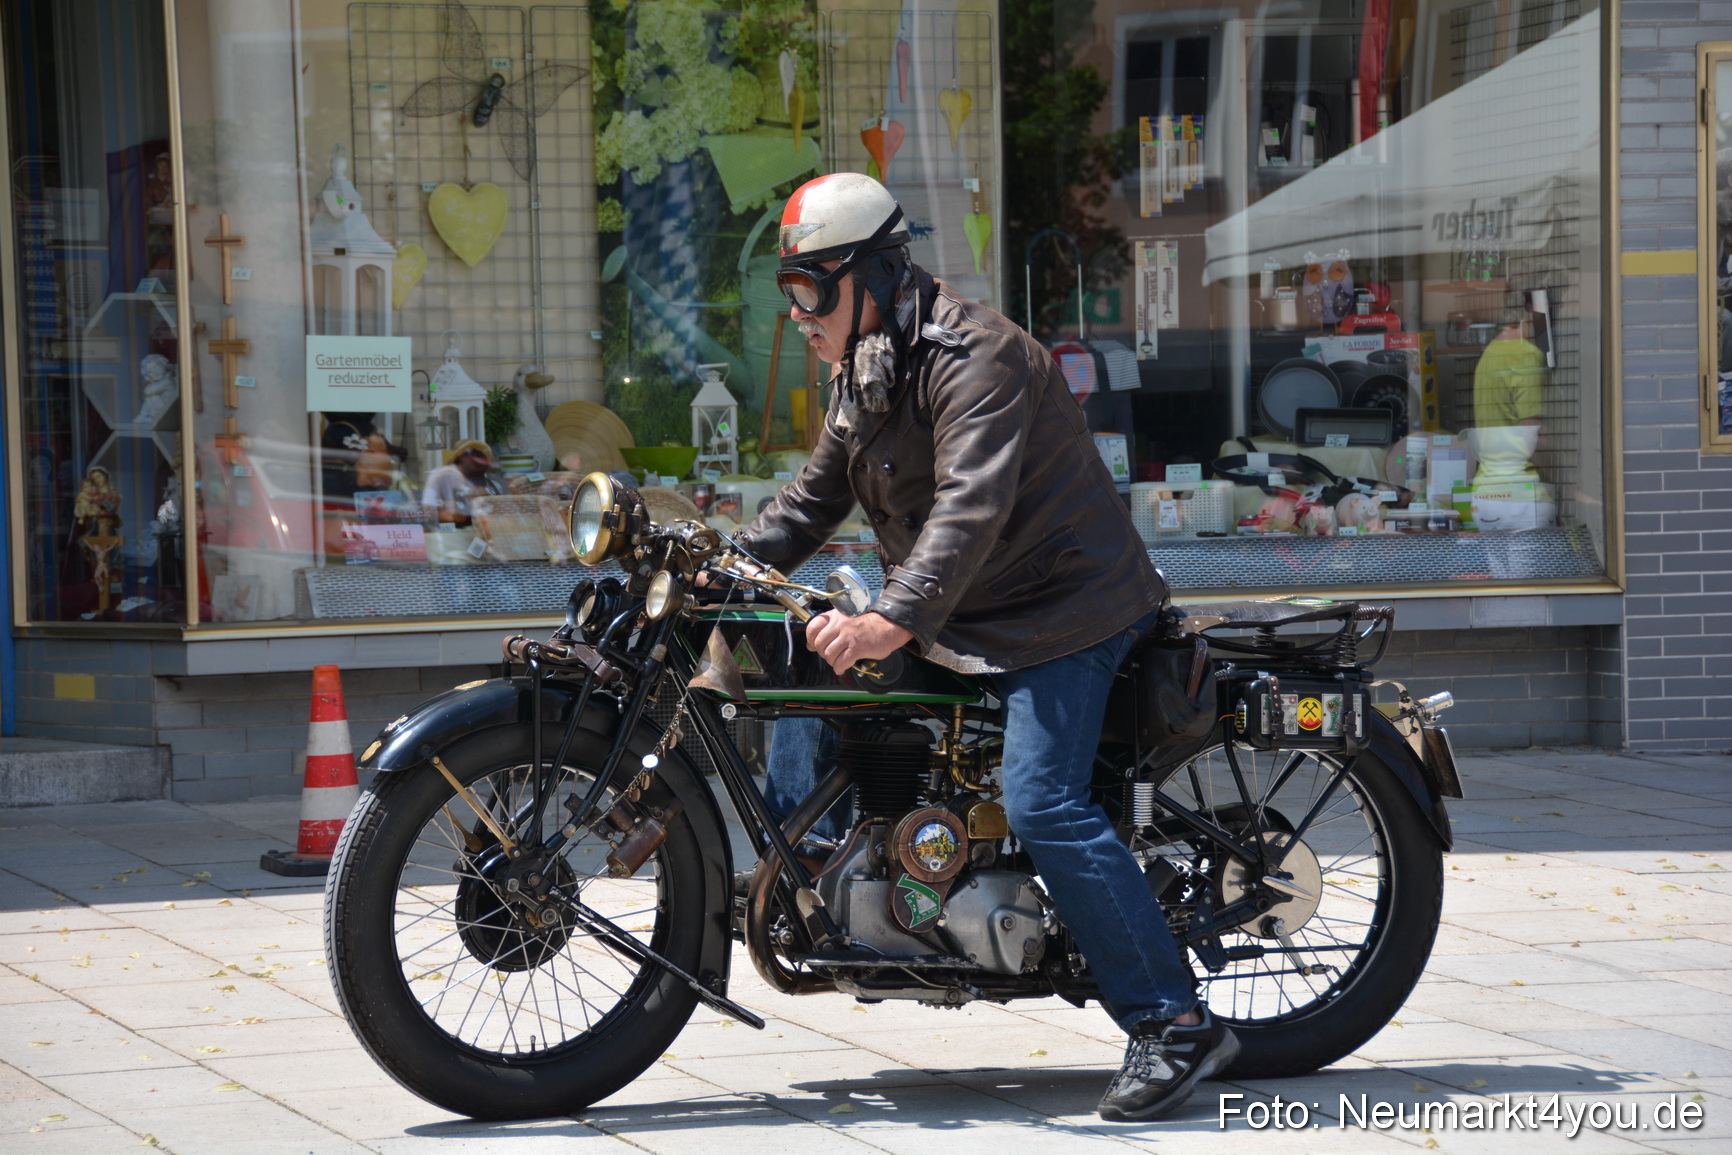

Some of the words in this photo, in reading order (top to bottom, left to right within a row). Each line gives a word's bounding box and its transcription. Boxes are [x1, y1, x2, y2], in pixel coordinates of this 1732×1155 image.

[1354, 316, 1387, 324] Zugreifen!
[1354, 339, 1381, 348] FORME
[1389, 337, 1412, 345] 3er-Set
[315, 353, 402, 367] Gartenmöbel
[328, 372, 390, 384] reduziert
[387, 530, 412, 539] Held
[392, 539, 409, 548] des
[389, 549, 416, 558] Tages
